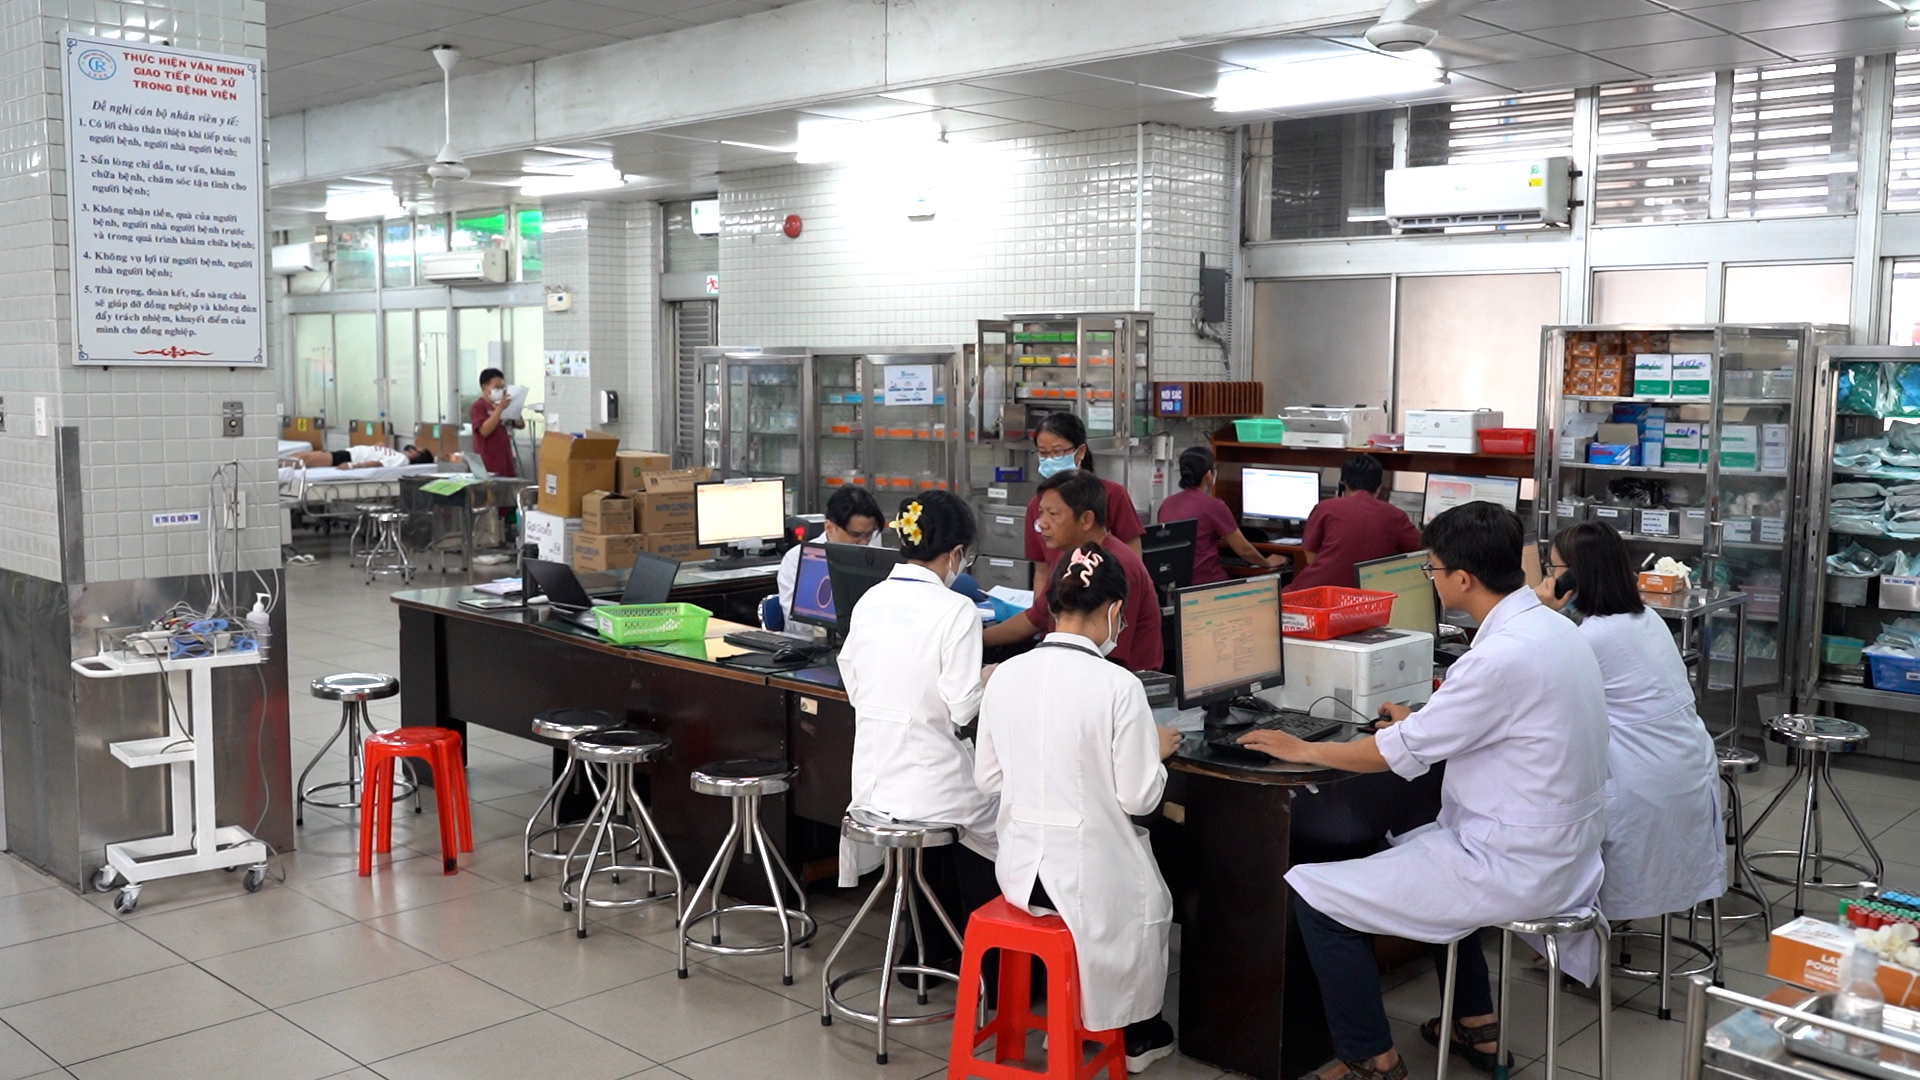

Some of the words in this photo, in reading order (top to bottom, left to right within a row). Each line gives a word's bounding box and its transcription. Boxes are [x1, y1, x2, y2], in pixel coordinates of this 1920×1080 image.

[122, 52, 155, 64] THỰC
[159, 56, 187, 68] HIỆN
[216, 65, 245, 76] MINH
[133, 66, 161, 78] GIAO
[164, 70, 191, 81] TIẾP
[194, 73, 218, 85] ỨNG
[221, 77, 237, 88] XỬ
[133, 79, 173, 92] TRONG
[176, 84, 208, 96] BỆNH
[211, 89, 237, 101] VIỆN
[109, 103, 132, 116] nghị
[134, 106, 153, 117] cán
[155, 107, 168, 120] bộ
[170, 110, 195, 121] nhân
[198, 113, 217, 124] viên
[219, 118, 225, 127] y
[227, 115, 239, 127] tế:
[79, 118, 86, 127] 1.
[88, 118, 102, 128] Có
[104, 120, 116, 130] lời
[118, 122, 140, 132] chào
[141, 124, 162, 135] thân
[163, 127, 186, 138] thiện
[188, 130, 202, 139] khi
[203, 131, 221, 143] tiếp
[222, 134, 237, 143] xúc
[238, 135, 251, 144] với
[89, 134, 115, 145] người
[117, 136, 142, 147] bệnh,
[144, 140, 169, 150] người
[170, 142, 186, 151] nhà
[188, 145, 212, 154] người
[213, 146, 238, 157] bệnh;
[80, 154, 88, 163] 2.
[91, 154, 110, 165] Sẵn
[112, 157, 134, 169] lòng
[136, 160, 150, 169] chỉ
[152, 160, 173, 172] dẫn,
[176, 164, 186, 172] tư
[188, 164, 208, 175] vấn,
[210, 166, 236, 177] khám
[91, 169, 116, 180] chữa
[118, 171, 146, 183] bệnh,
[147, 175, 174, 184] chăm
[176, 177, 191, 186] sóc
[193, 179, 209, 188] tận
[211, 180, 229, 190] tình
[231, 182, 247, 191] cho
[92, 184, 120, 194] người
[122, 185, 150, 197] bệnh;
[81, 203, 90, 212] 3.
[93, 204, 125, 216] Không
[127, 207, 150, 217] nhận
[153, 208, 174, 219] tiền,
[176, 211, 192, 221] quà
[194, 211, 211, 221] của
[213, 214, 238, 223] người
[93, 217, 120, 228] bệnh,
[122, 221, 149, 230] người
[150, 222, 168, 231] nhà
[170, 224, 196, 233] người
[197, 225, 219, 235] bệnh
[221, 227, 245, 236] trước
[93, 231, 105, 240] và
[107, 232, 133, 243] trong
[135, 234, 152, 243] quá
[155, 235, 178, 244] trình
[180, 236, 206, 246] khám
[207, 239, 229, 247] chữa
[231, 240, 255, 250] bệnh;
[83, 251, 92, 259] 4.
[95, 251, 128, 263] Không
[130, 255, 142, 263] vụ
[144, 254, 157, 264] lợi
[159, 255, 170, 264] từ
[172, 256, 198, 266] người
[200, 257, 225, 268] bệnh,
[228, 260, 253, 269] người
[95, 265, 113, 274] nhà
[116, 267, 143, 276] người
[145, 267, 173, 278] bệnh;
[84, 285, 93, 294] 5.
[95, 285, 114, 295] Tôn
[116, 287, 145, 297] trọng,
[146, 288, 169, 297] đoàn
[171, 288, 189, 299] kết,
[190, 288, 206, 298] sẵn
[207, 290, 227, 300] sàng
[96, 325, 119, 334] mình
[121, 326, 138, 334] cho
[140, 325, 162, 336] đồng
[165, 327, 197, 338] nghiệp.
[1821, 953, 1839, 966] LA
